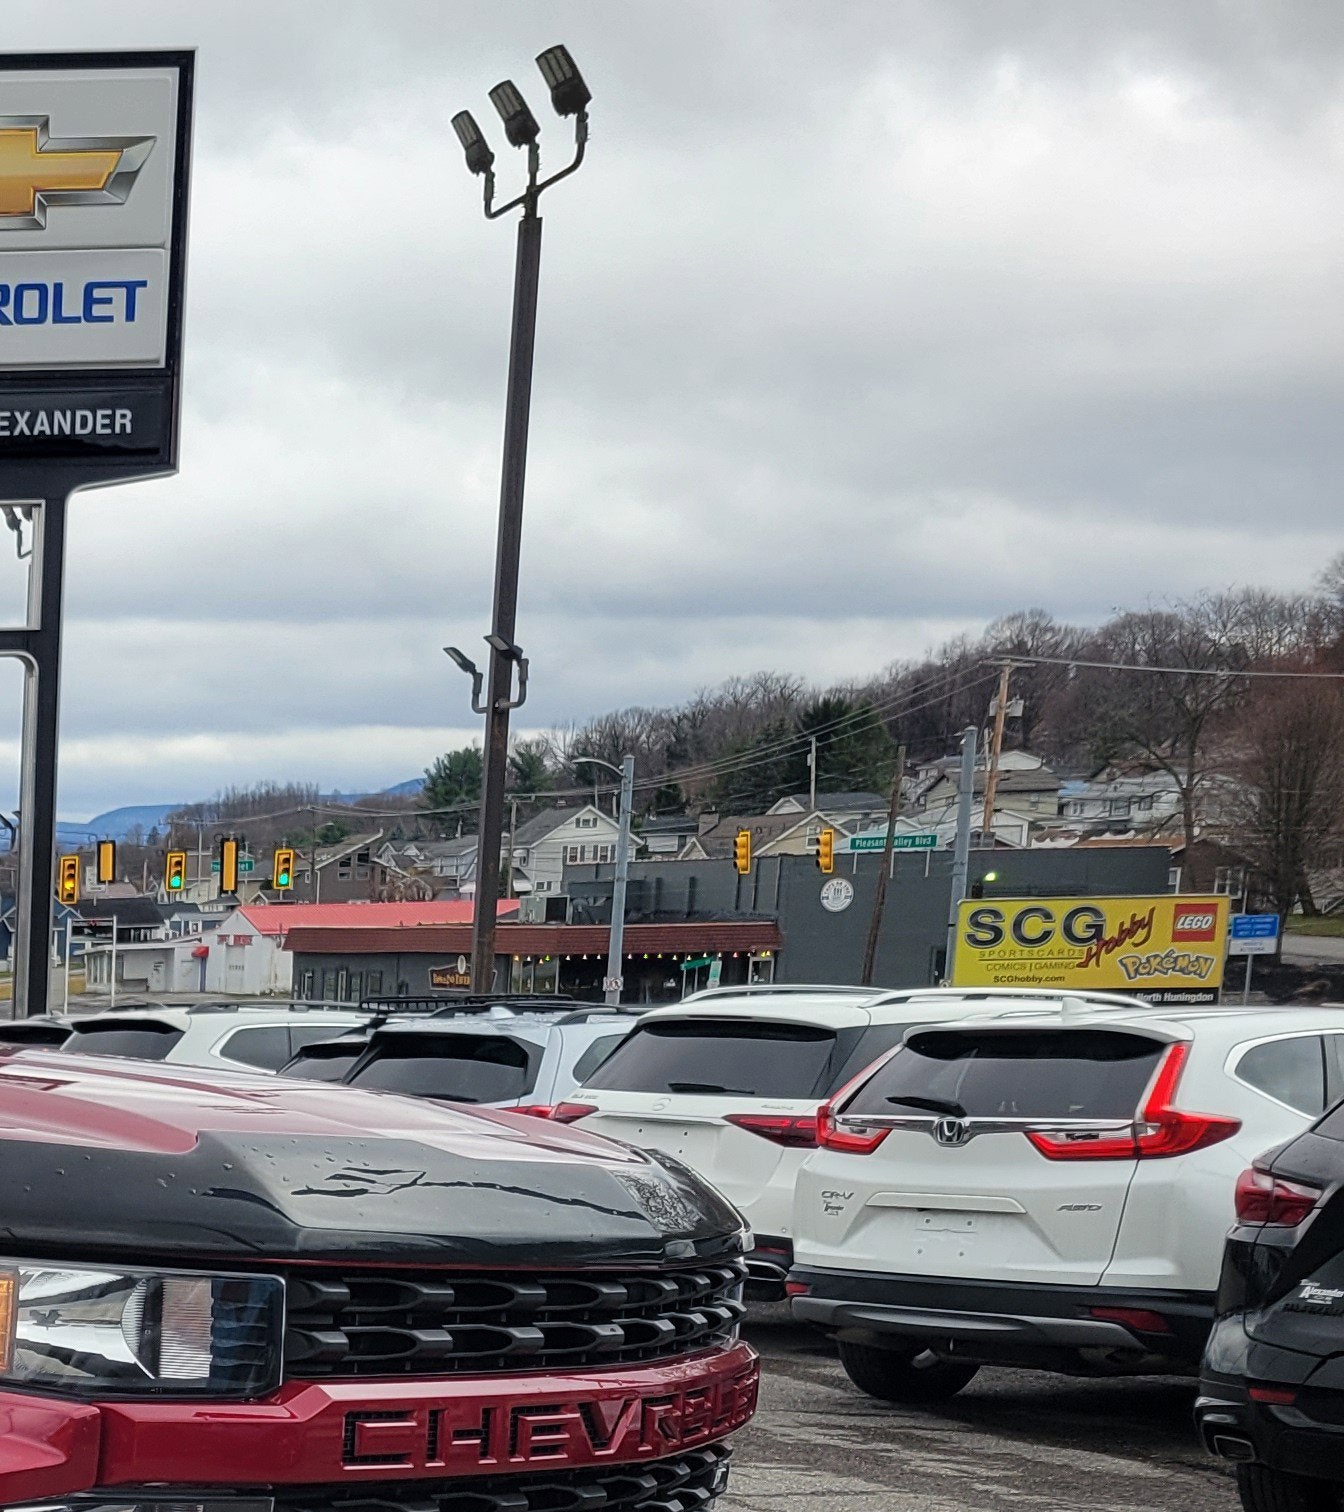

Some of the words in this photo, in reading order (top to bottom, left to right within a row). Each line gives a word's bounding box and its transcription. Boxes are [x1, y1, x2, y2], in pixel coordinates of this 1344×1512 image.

[893, 837, 913, 848] alley
[915, 836, 932, 845] Blvd
[1175, 913, 1214, 931] LEGO
[964, 904, 1105, 949] SCG
[1076, 906, 1156, 969] Hobby
[979, 948, 1085, 958] SPORTSCARDS
[986, 961, 1027, 972] COMICS
[1034, 961, 1076, 971] GAMING
[993, 974, 1066, 984] SCGhobby.com
[1136, 992, 1162, 1002] North
